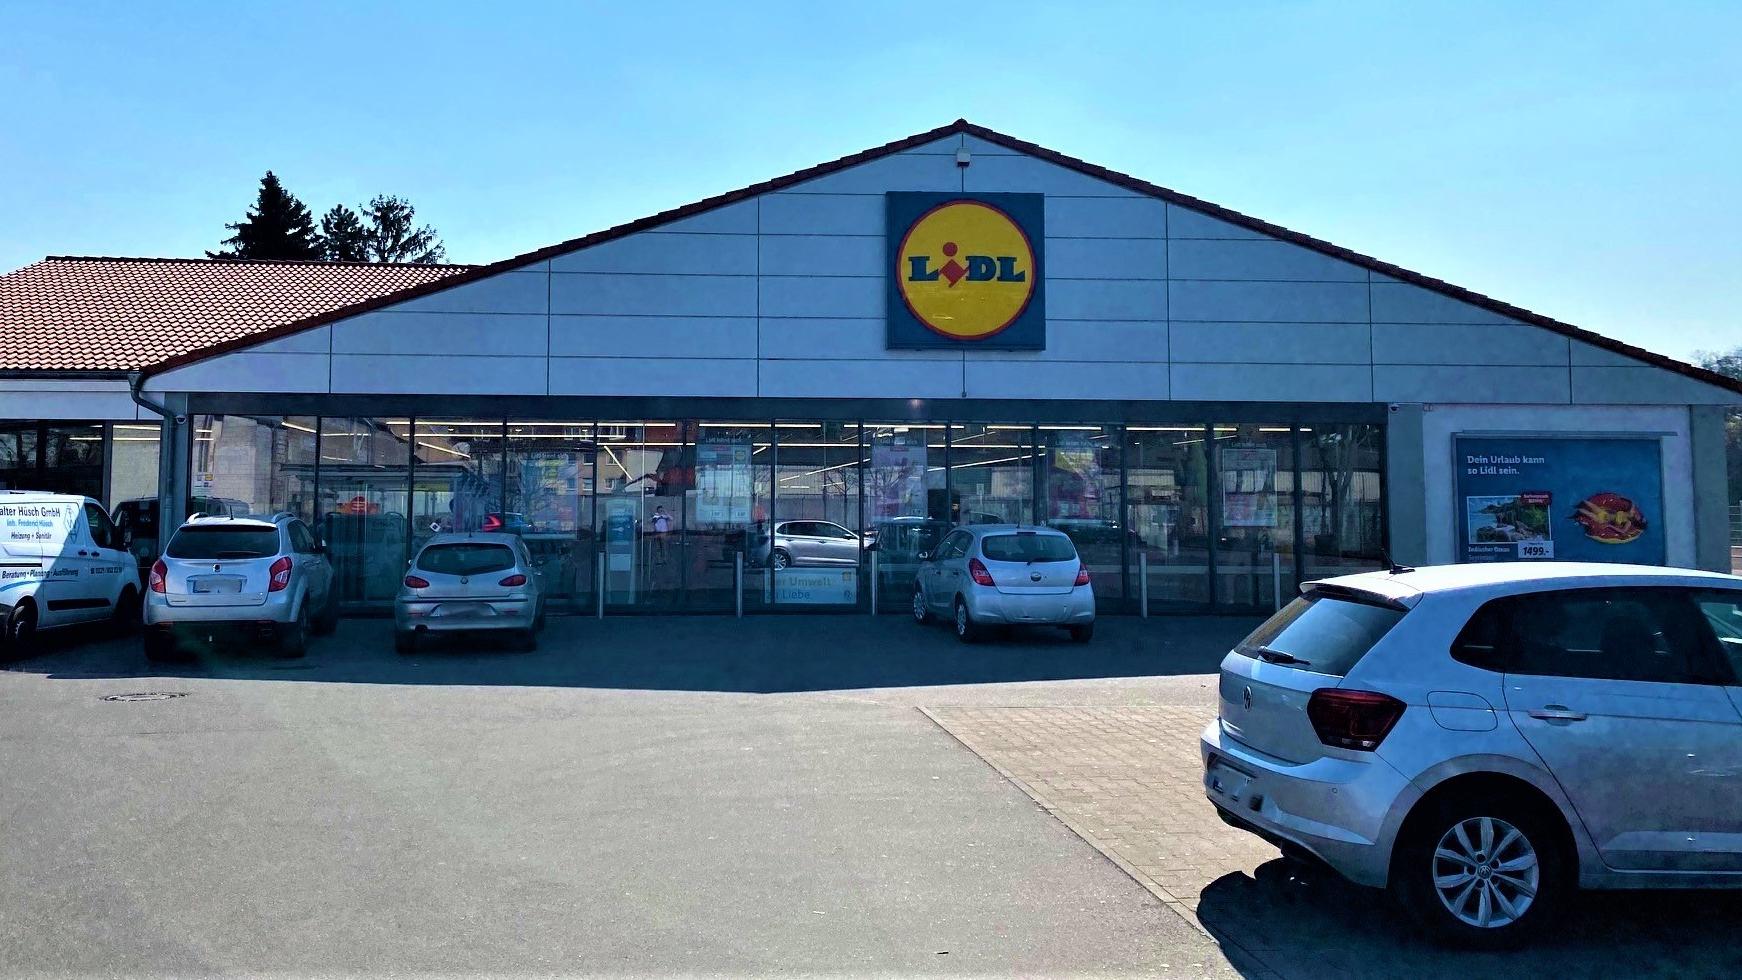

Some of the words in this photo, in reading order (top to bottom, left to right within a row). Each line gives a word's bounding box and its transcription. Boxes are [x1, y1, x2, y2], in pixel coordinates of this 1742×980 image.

[1467, 455, 1489, 464] Dein
[1490, 455, 1521, 464] Urlaub
[1522, 455, 1545, 464] kann
[1479, 466, 1497, 475] Lidl
[1498, 466, 1520, 475] sein.
[18, 506, 40, 517] Hüsch
[41, 507, 61, 518] GmbH
[1523, 547, 1550, 556] 1499.-
[2, 570, 27, 579] Beratung
[789, 576, 832, 587] Umwelt
[782, 589, 810, 600] Liebe
